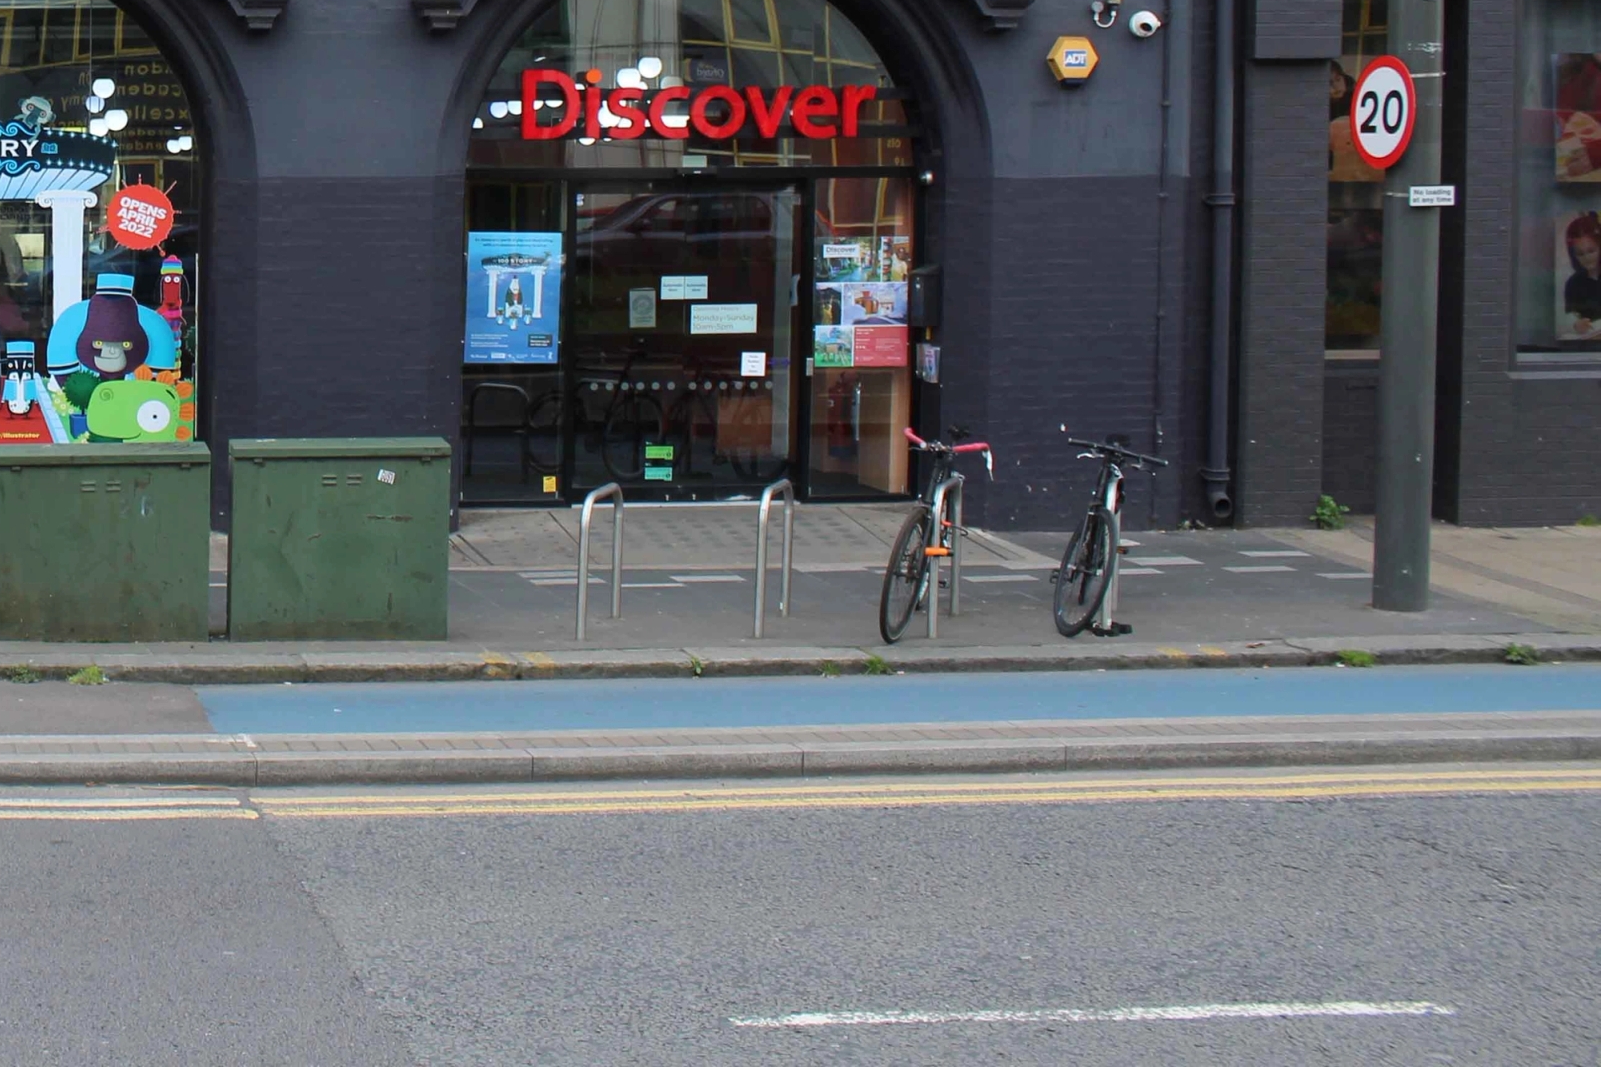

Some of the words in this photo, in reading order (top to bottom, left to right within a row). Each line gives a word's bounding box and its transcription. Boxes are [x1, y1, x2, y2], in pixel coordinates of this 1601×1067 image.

[1065, 53, 1087, 65] ADT
[521, 69, 877, 139] Discover
[1360, 90, 1403, 134] 20
[117, 207, 158, 229] APRIL
[120, 196, 168, 220] OPENS
[118, 218, 155, 239] 2022
